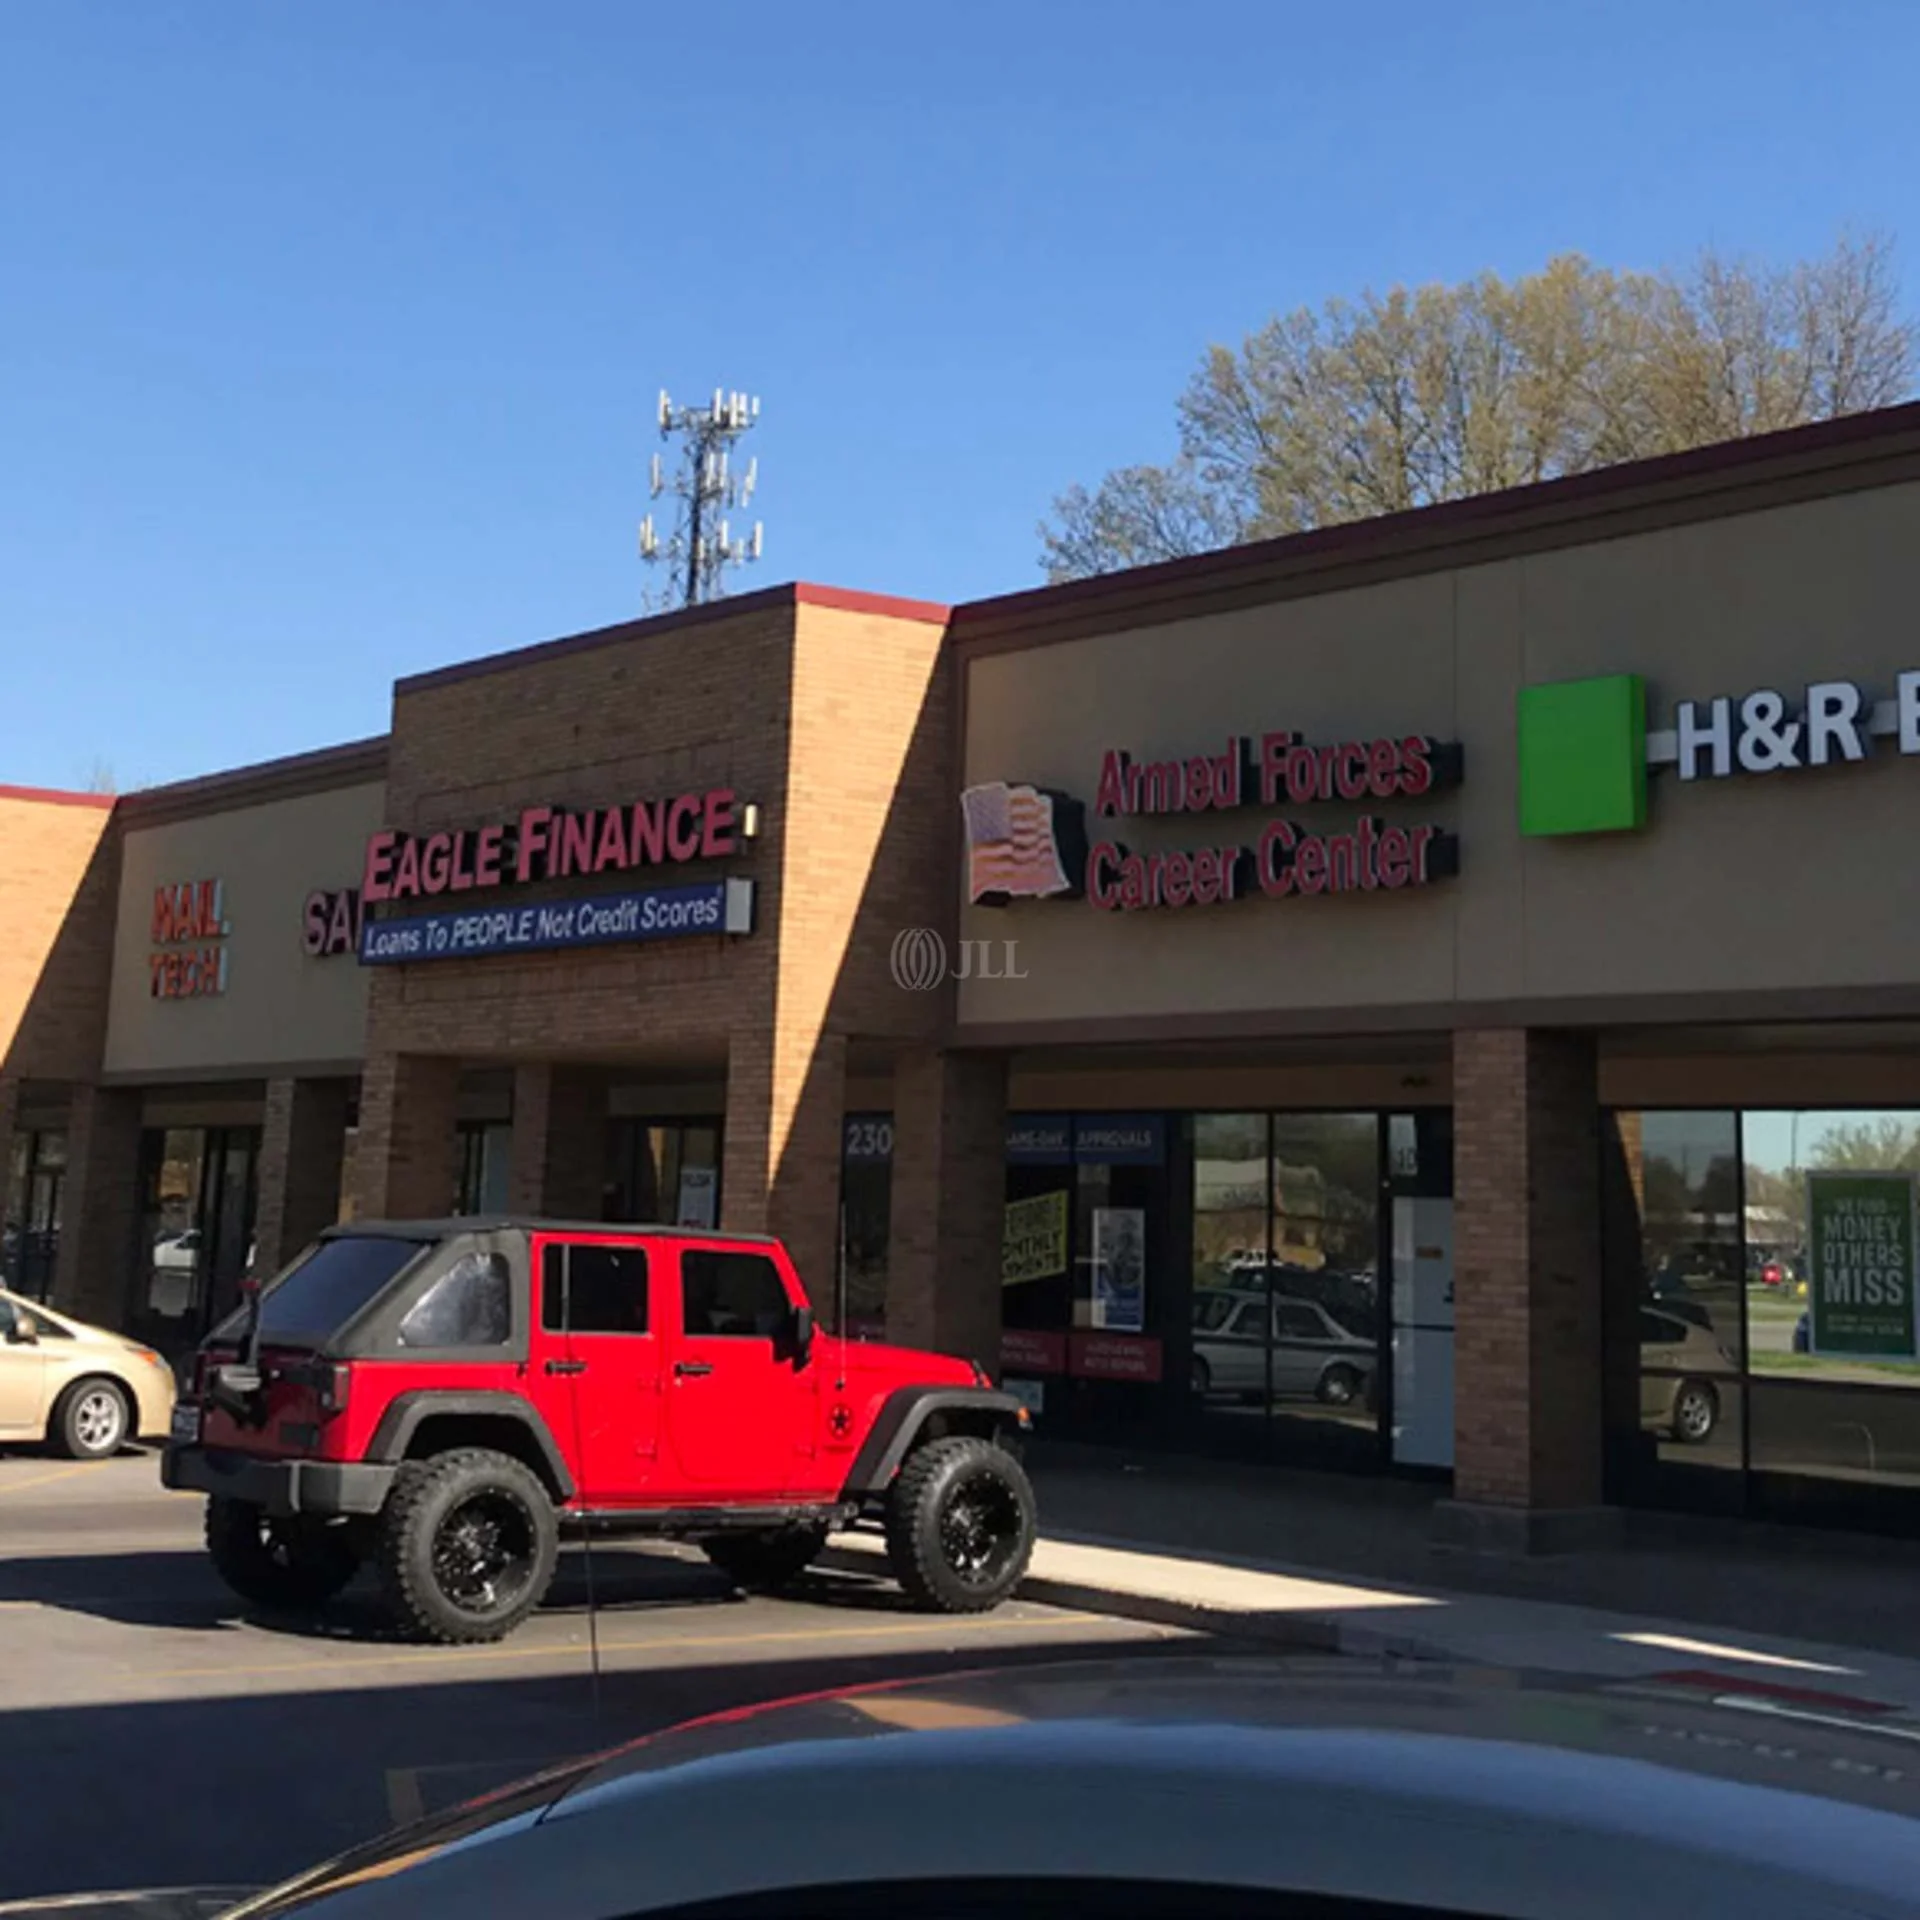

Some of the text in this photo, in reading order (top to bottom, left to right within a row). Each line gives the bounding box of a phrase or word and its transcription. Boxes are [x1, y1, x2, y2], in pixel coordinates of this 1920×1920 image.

[1677, 681, 1865, 780] H&R
[1098, 732, 1432, 816] Armed Forces
[363, 788, 735, 900] EAGLE FINANCE
[1086, 816, 1431, 909] Career Center
[152, 878, 228, 943] NAIL
[303, 888, 364, 957] SA
[364, 896, 719, 957] Loans To PEOPLE Not Credit Scores
[149, 946, 227, 998] TECH
[1823, 1215, 1902, 1241] MONEY
[1823, 1241, 1905, 1268] OTHERS
[1823, 1267, 1905, 1307] MISS
